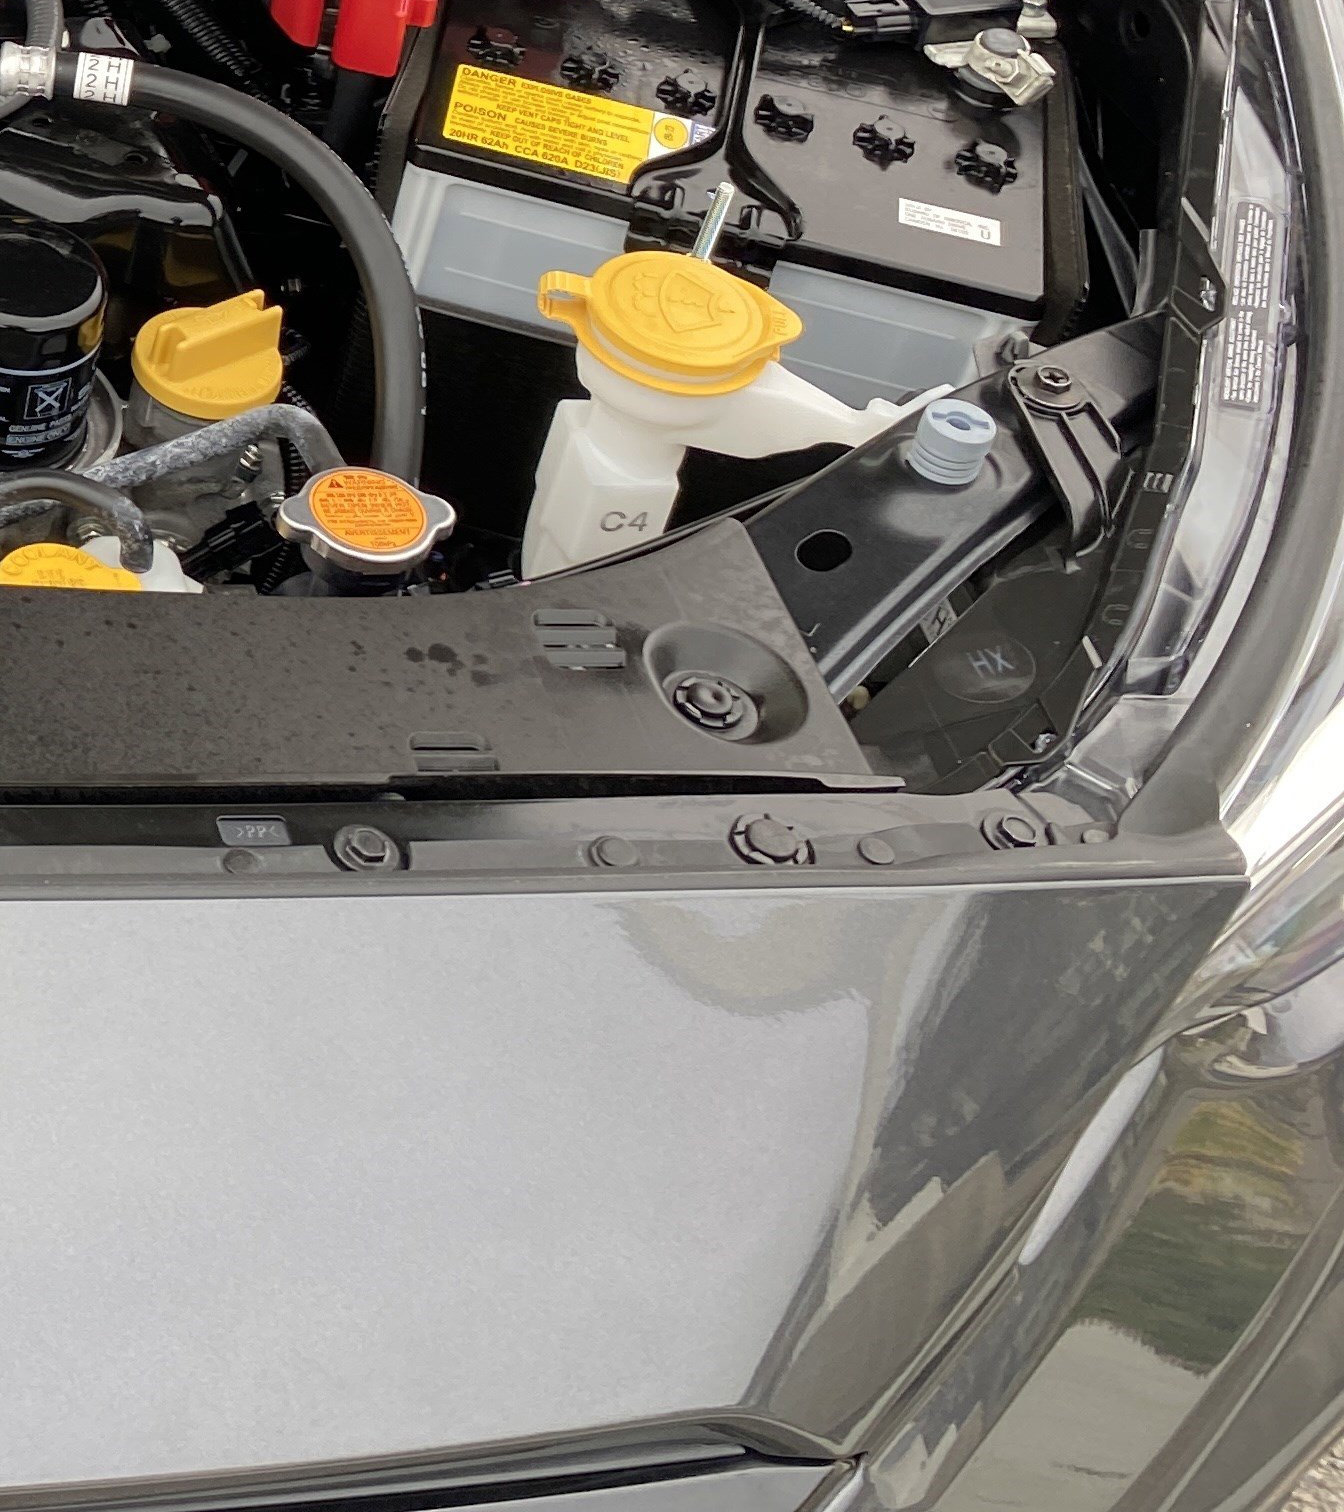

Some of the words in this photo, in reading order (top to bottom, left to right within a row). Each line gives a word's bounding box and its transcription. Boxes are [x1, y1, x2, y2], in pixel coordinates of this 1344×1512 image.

[88, 58, 100, 71] 2
[107, 60, 122, 74] H
[85, 74, 98, 88] 2
[104, 76, 119, 91] H
[462, 68, 517, 87] DANGER
[84, 90, 95, 100] 2
[103, 92, 116, 102] H
[454, 102, 507, 122] POISON
[514, 117, 546, 131] CAUSES
[548, 126, 578, 139] SEVERE
[580, 133, 608, 146] BURNS
[496, 103, 518, 114] KEEP
[518, 109, 539, 119] VENT
[540, 114, 562, 125] CAPS
[564, 118, 586, 132] TIGHT
[588, 126, 604, 136] AND
[606, 130, 630, 143] LEVEL
[449, 128, 479, 142] 20HR
[481, 136, 510, 150] 62Ah
[514, 144, 539, 158] CCA
[542, 152, 568, 166] 620A
[490, 130, 512, 140] KEEP
[512, 135, 529, 145] OUT
[530, 140, 540, 148] OF
[542, 143, 570, 156] REACH
[572, 150, 582, 158] OF
[584, 152, 624, 170] CHILDREN
[980, 228, 991, 240] U
[8, 424, 47, 432] GENUINE
[8, 434, 46, 444] ENGINE
[600, 511, 648, 532] C4
[966, 646, 1015, 680] HX
